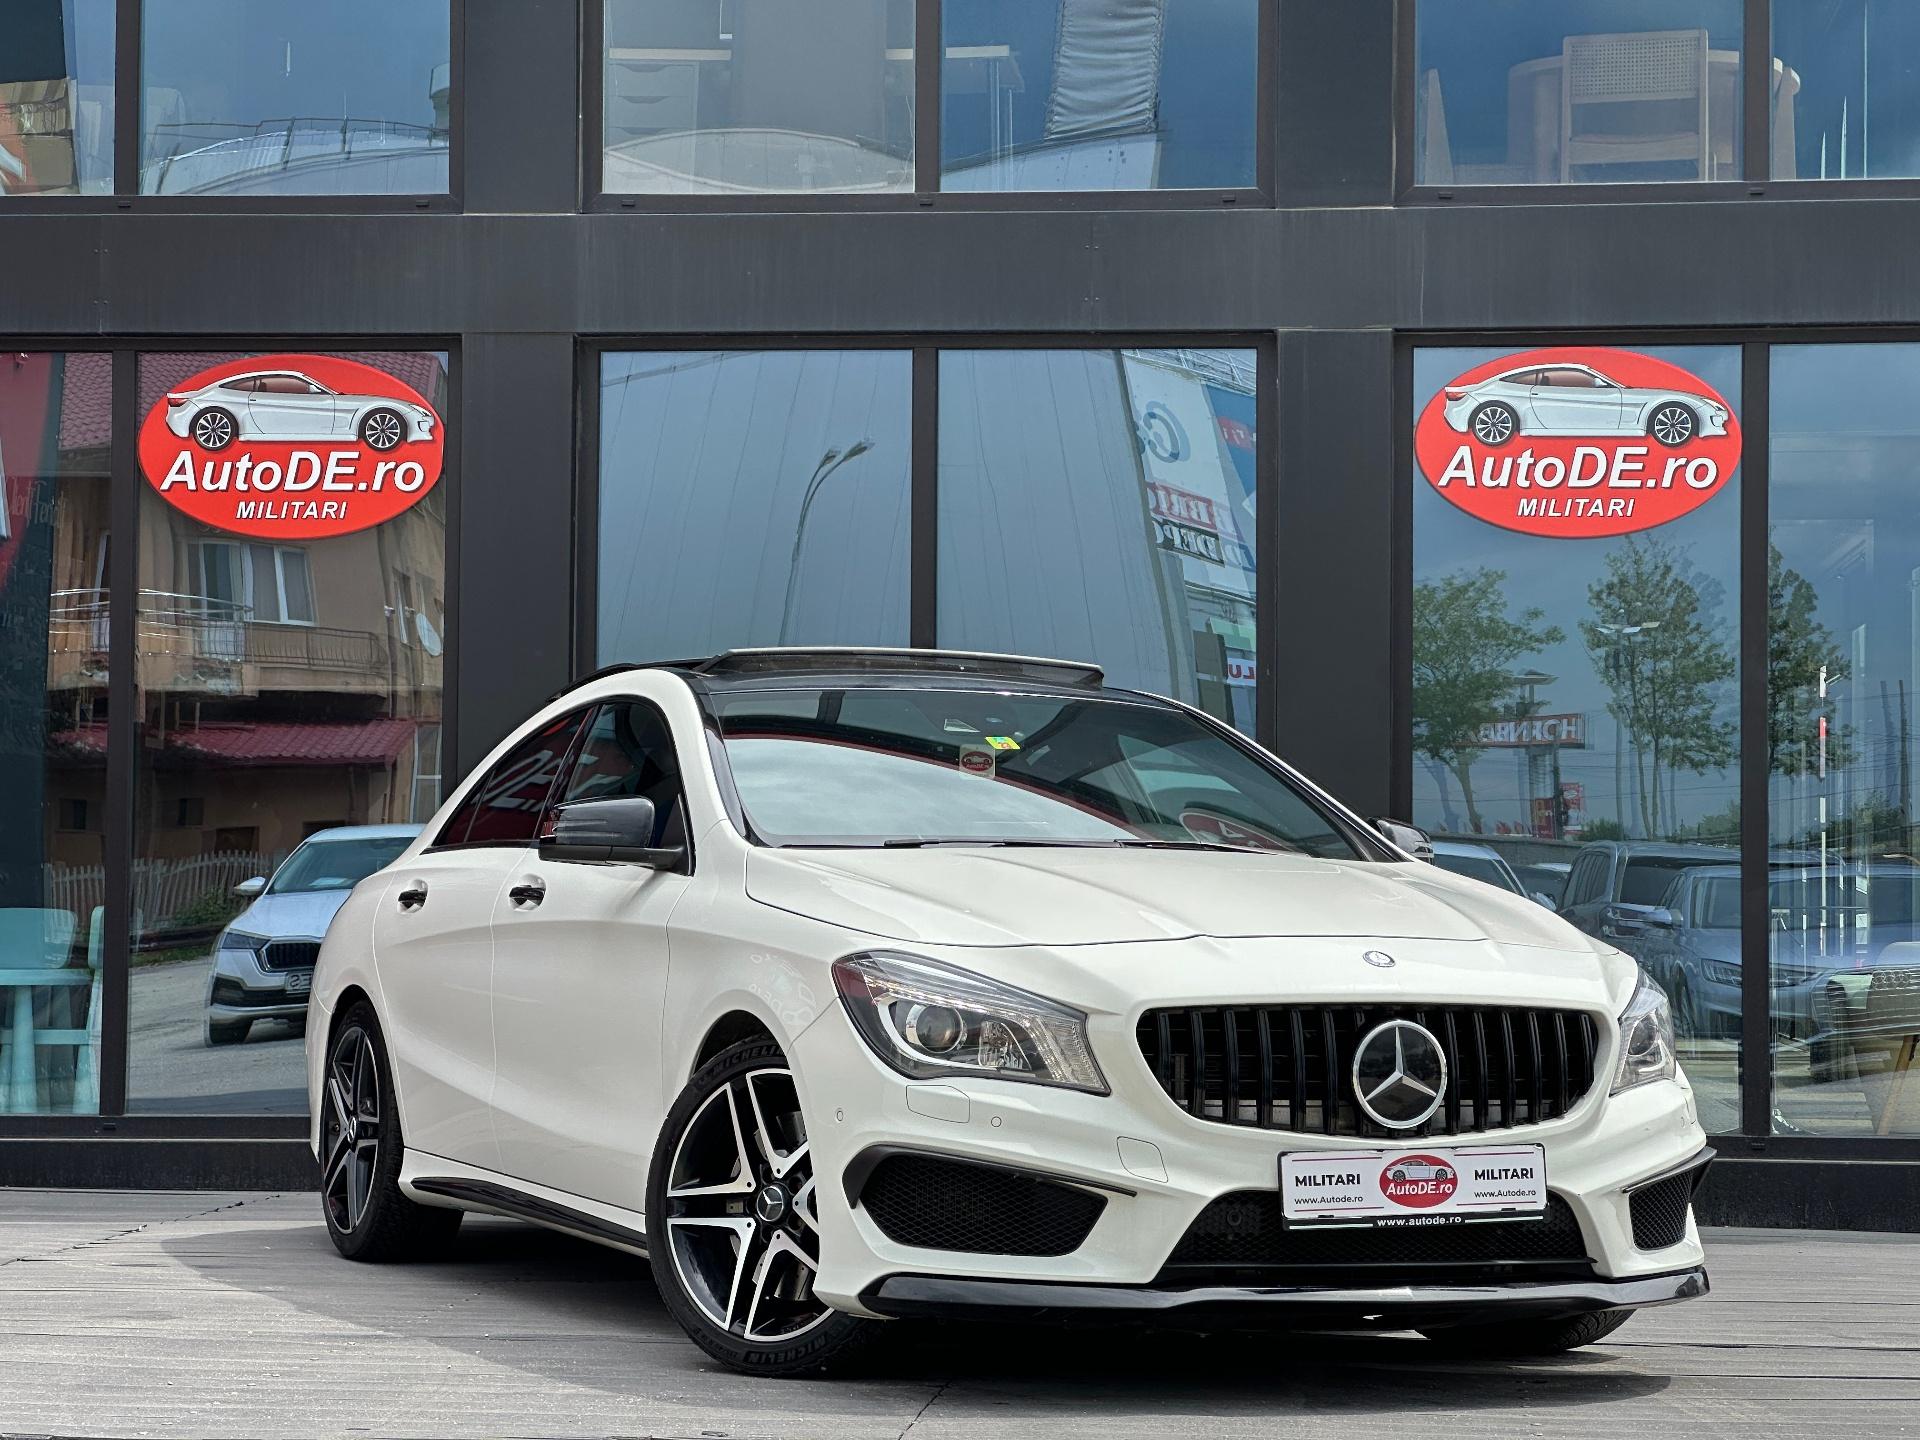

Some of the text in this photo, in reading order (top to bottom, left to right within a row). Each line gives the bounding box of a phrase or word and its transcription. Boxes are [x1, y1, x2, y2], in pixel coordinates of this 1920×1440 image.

[159, 450, 425, 493] AutoDE.ro
[1438, 445, 1718, 490] AutoDE.ro
[236, 501, 348, 520] MILITARI
[1517, 498, 1635, 518] MILITARI
[1295, 1173, 1361, 1187] MILITARI
[1474, 1167, 1534, 1181] MILITARI
[1386, 1181, 1453, 1196] AutoDE.ro
[1474, 1188, 1537, 1198] www.Autode.ro
[1294, 1195, 1364, 1205] www.Autode.ro
[1376, 1215, 1462, 1227] www.autode.ro
[750, 1335, 827, 1364] MICHELIN
